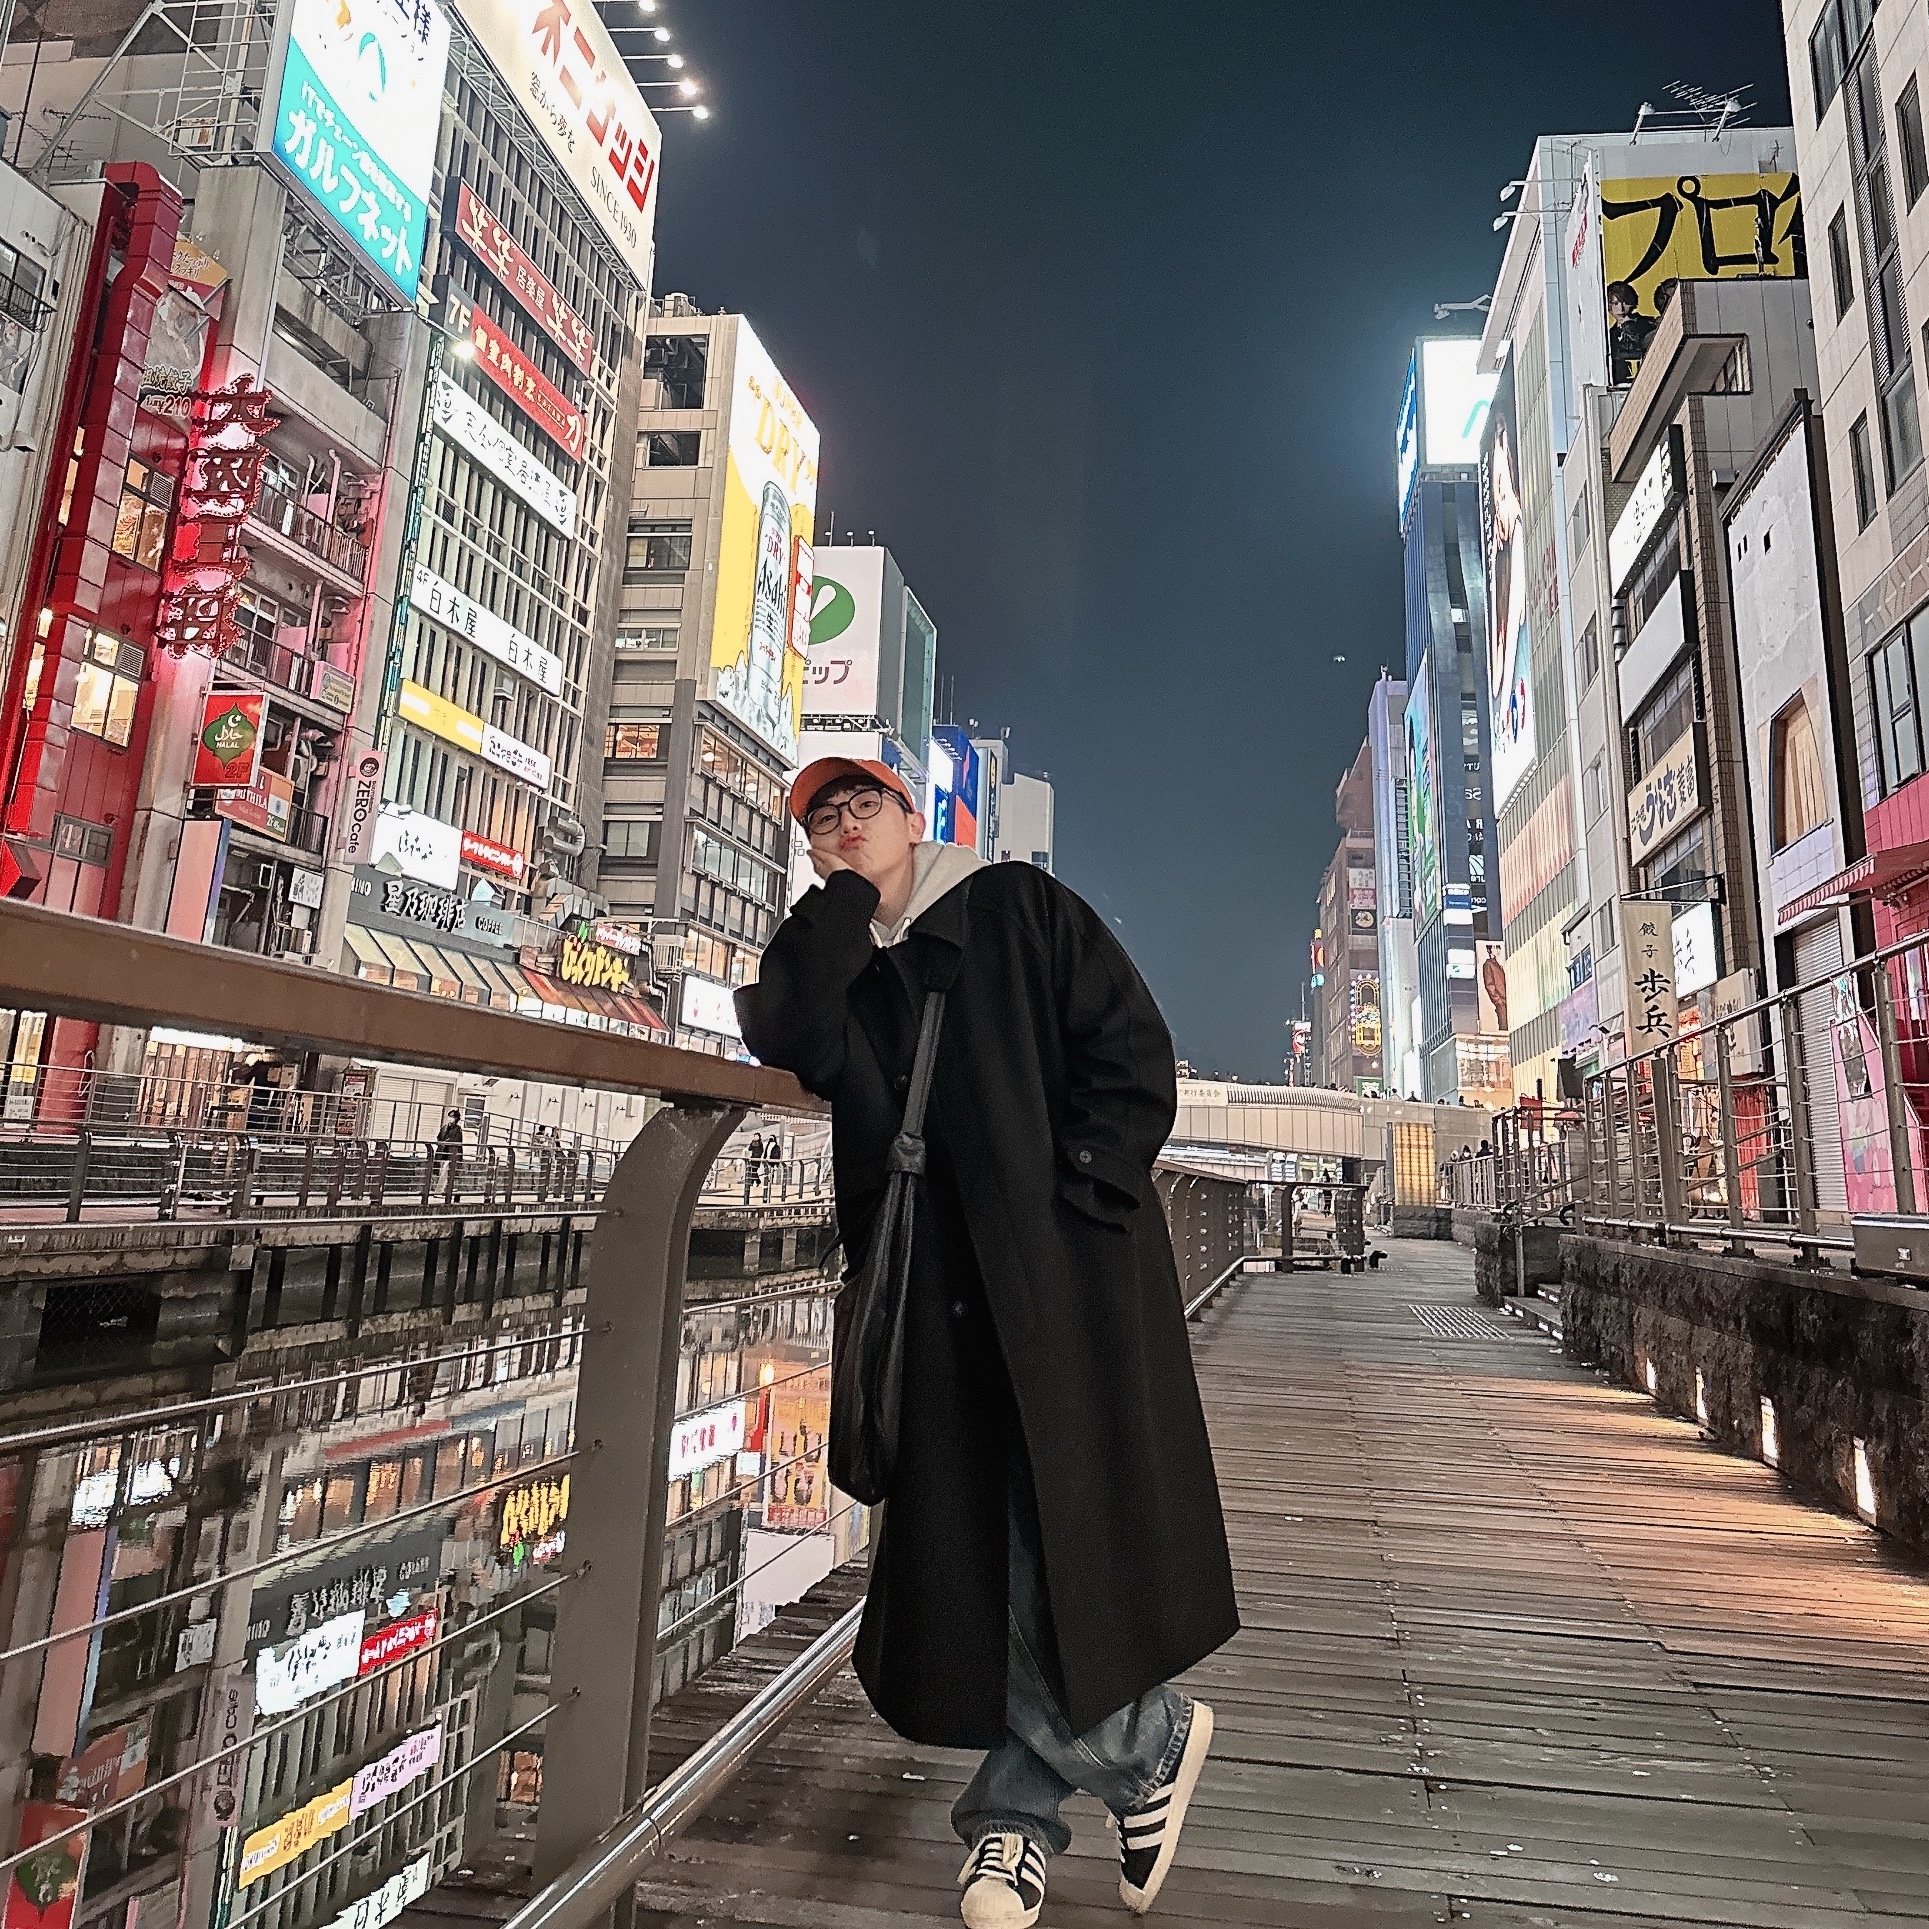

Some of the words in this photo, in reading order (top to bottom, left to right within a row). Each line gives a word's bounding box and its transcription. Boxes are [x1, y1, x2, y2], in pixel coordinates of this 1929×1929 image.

[284, 108, 413, 276] ガルフネット
[591, 166, 621, 222] SINCE
[619, 211, 637, 249] 1930
[448, 293, 473, 335] 7F
[563, 414, 582, 453] 刀
[764, 532, 787, 567] DRY
[757, 555, 787, 619] Asahi
[429, 579, 478, 639] 白木屋
[506, 632, 549, 685] 白木屋
[215, 724, 243, 742] حلال
[216, 741, 240, 750] HALAL
[225, 761, 251, 779] 2F
[354, 780, 373, 823] ZERO
[1638, 762, 1677, 847] うなぎ
[347, 822, 362, 854] cafe
[384, 879, 467, 932] 星乃珈琲店
[476, 915, 504, 936] COFFEE
[1639, 921, 1659, 959] 餃子
[1633, 967, 1673, 1039] 歩兵
